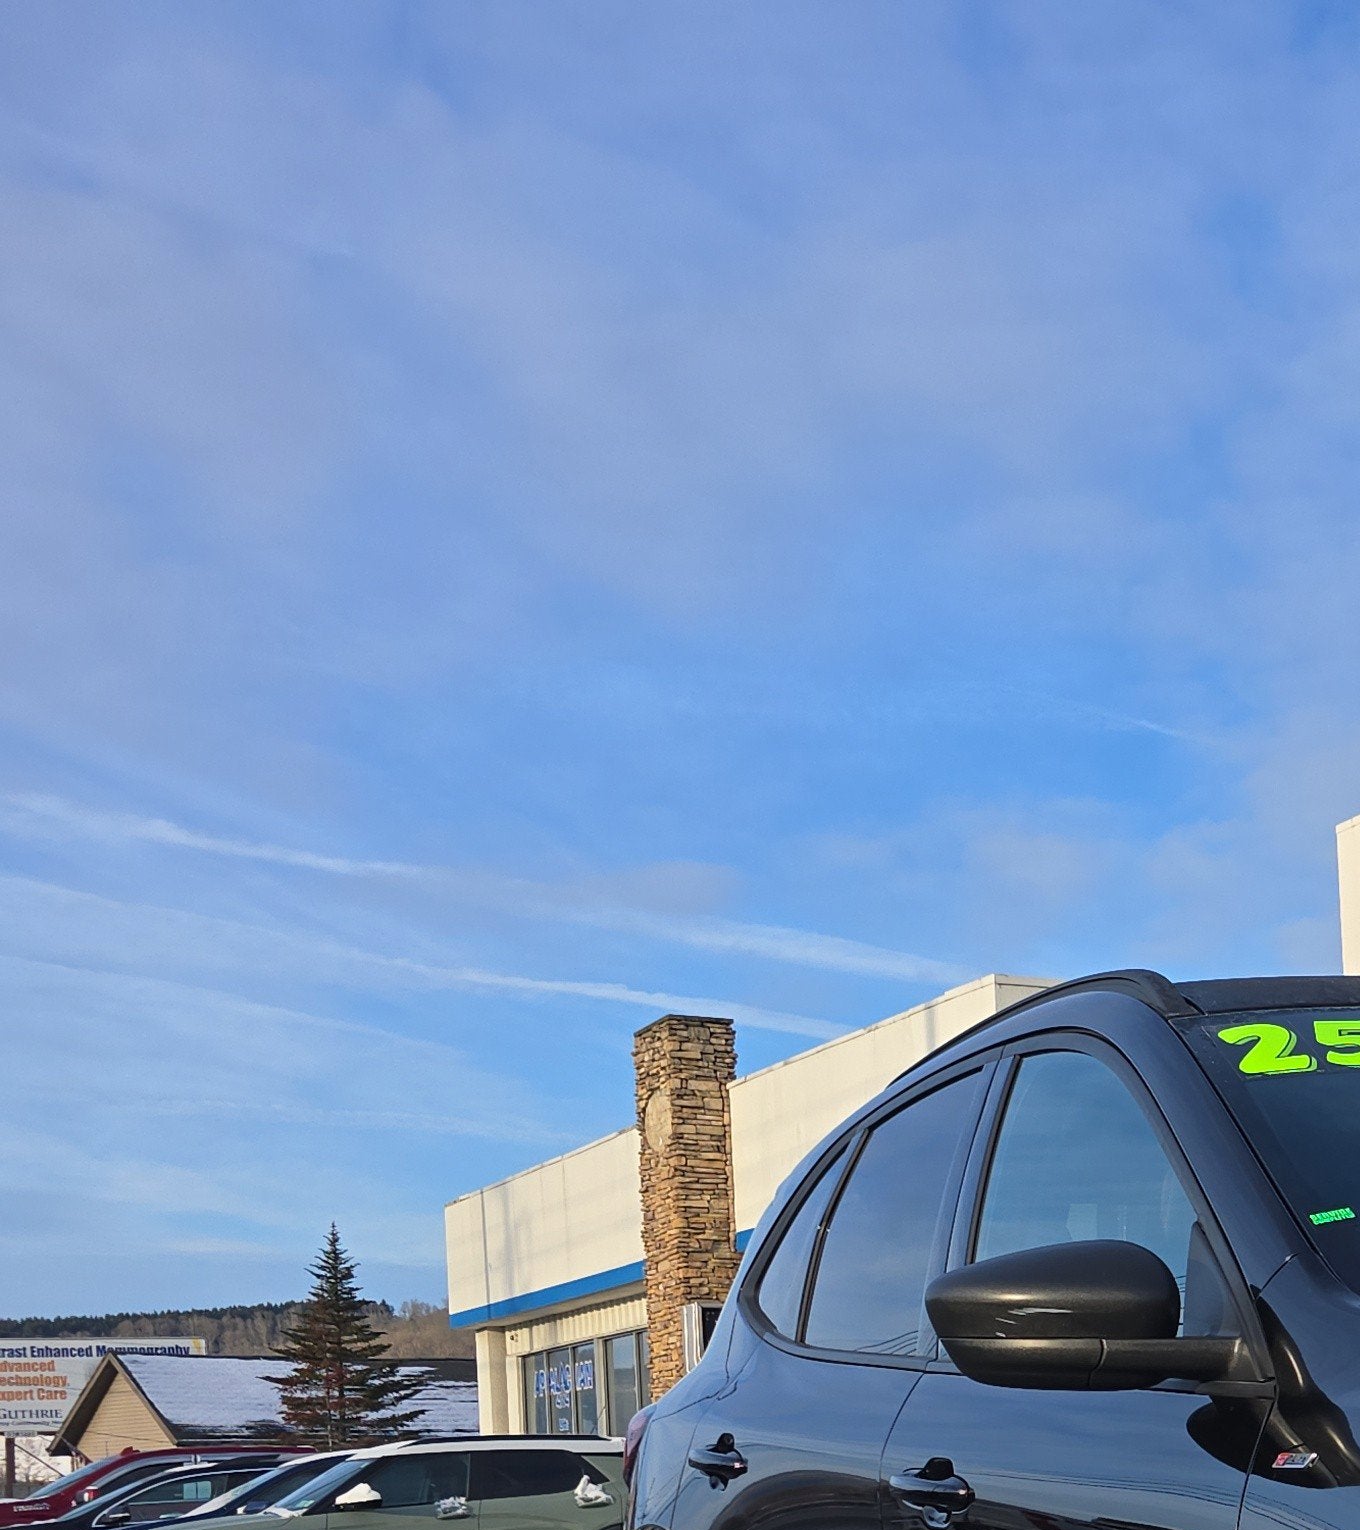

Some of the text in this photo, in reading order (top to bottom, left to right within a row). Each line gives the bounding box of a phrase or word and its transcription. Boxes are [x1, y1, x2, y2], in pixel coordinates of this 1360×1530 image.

[0, 1346, 27, 1358] rast
[30, 1345, 93, 1358] Enhanced
[37, 1388, 68, 1400] Care
